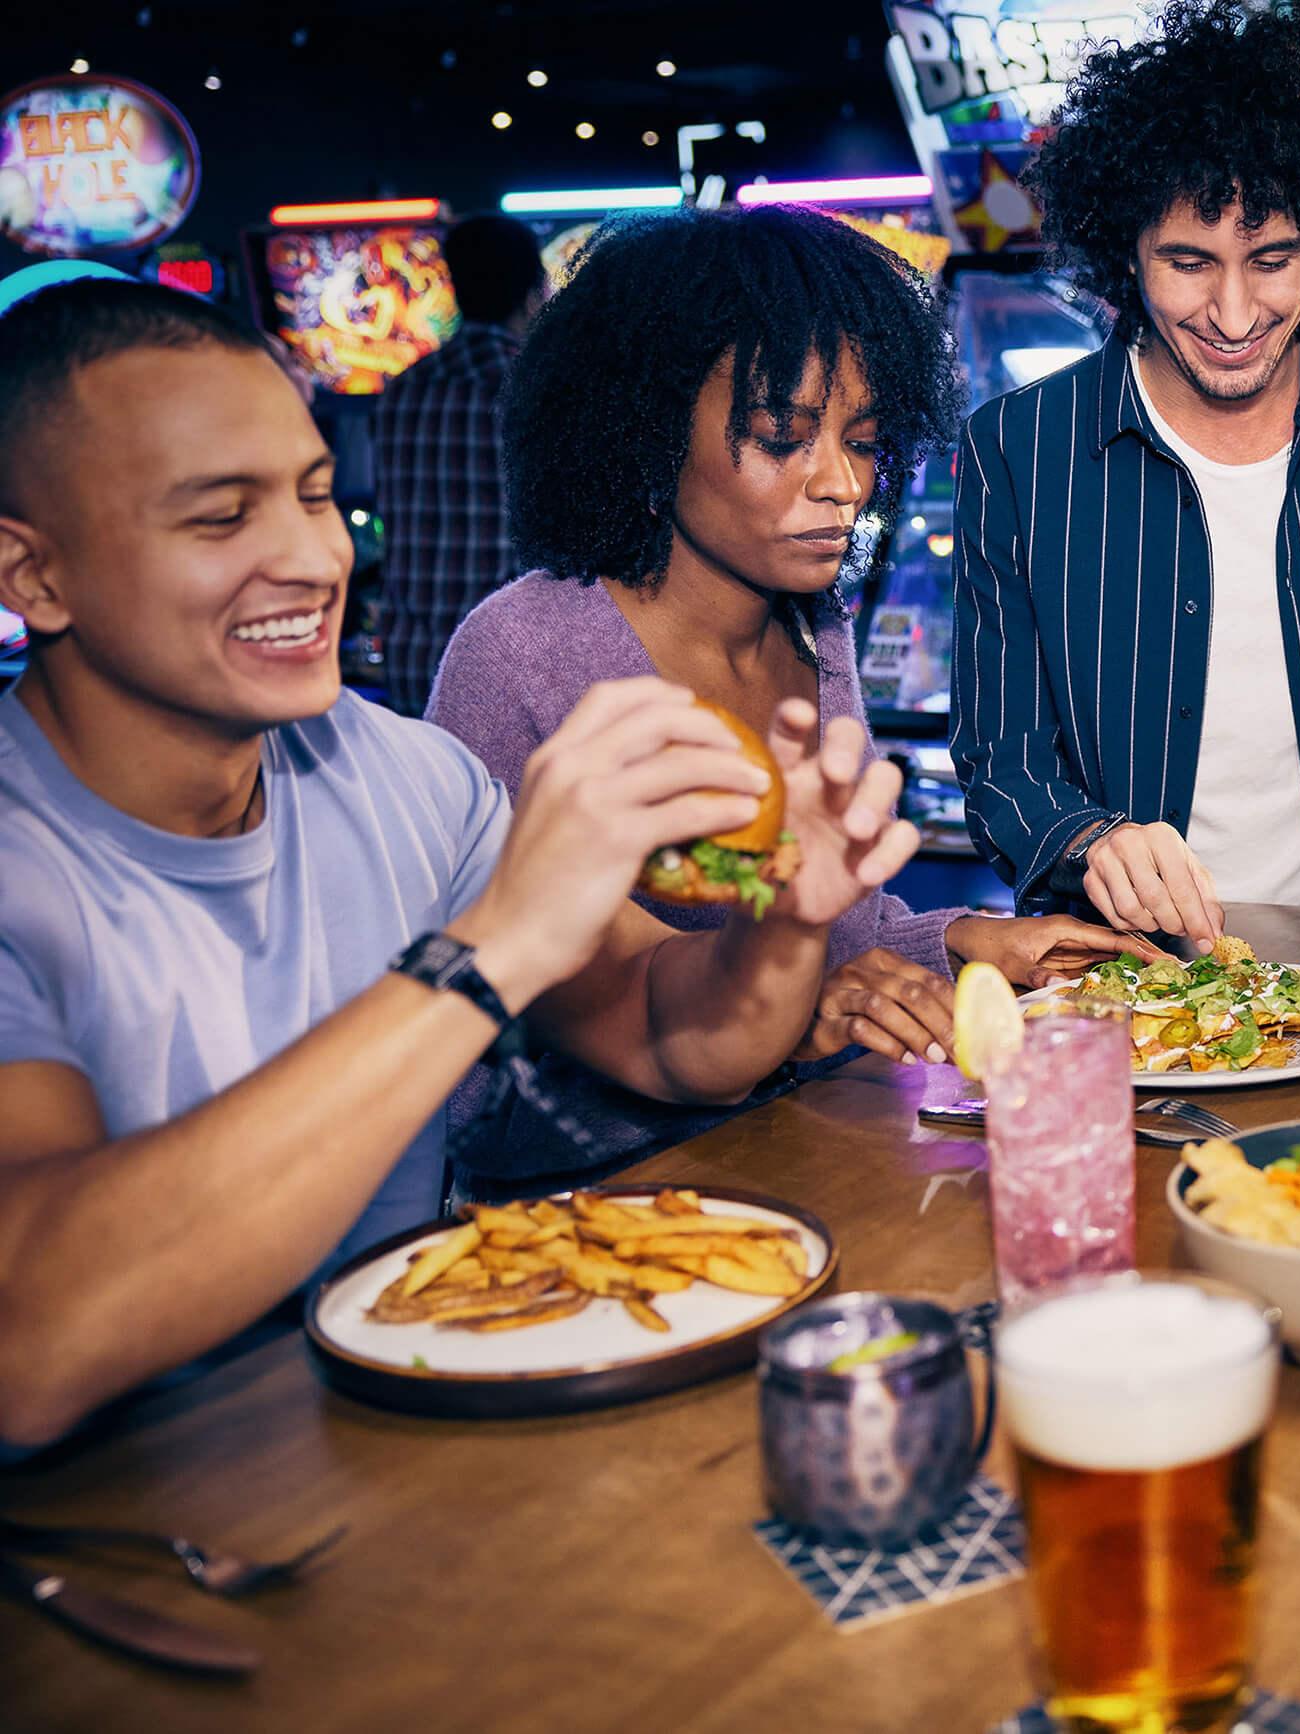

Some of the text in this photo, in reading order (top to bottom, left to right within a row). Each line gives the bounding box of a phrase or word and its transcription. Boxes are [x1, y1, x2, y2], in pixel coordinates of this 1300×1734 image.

[893, 6, 1142, 114] BAS
[19, 106, 131, 159] BLACK
[42, 159, 138, 207] HOLE
